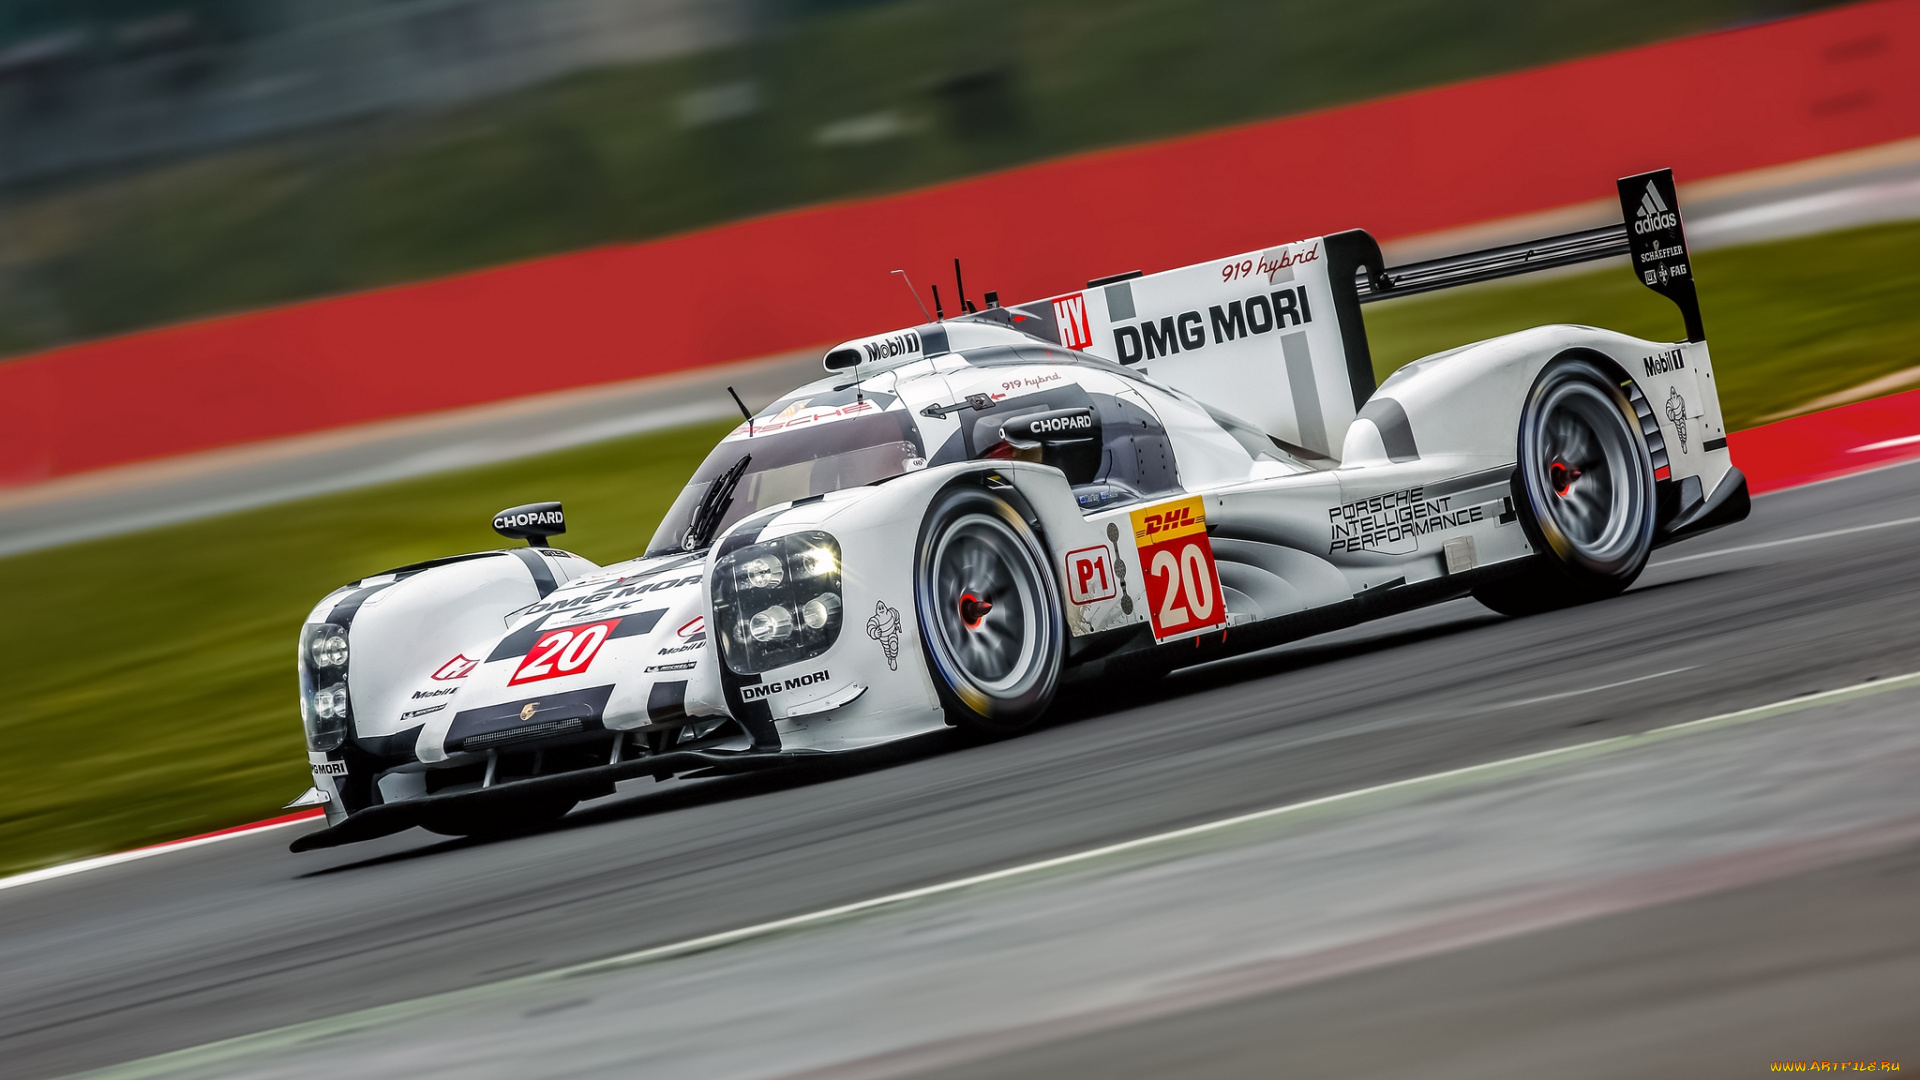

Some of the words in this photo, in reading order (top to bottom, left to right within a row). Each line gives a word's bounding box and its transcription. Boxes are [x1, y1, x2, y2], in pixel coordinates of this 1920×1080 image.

[1634, 212, 1677, 235] adidas
[1222, 260, 1252, 283] 919
[1256, 243, 1319, 284] hybrid
[1640, 245, 1684, 263] SCHAEFFLER
[1670, 264, 1687, 277] FAG
[1053, 296, 1087, 349] HY
[1112, 310, 1206, 366] DMG
[1208, 285, 1313, 345] MORI
[1001, 380, 1022, 391] 919
[1024, 372, 1062, 388] hybrid
[1030, 415, 1092, 433] CHOPARD
[494, 511, 564, 529] CHOPARD
[1144, 506, 1196, 536] DHL
[1328, 487, 1424, 523] PORSCHE
[1331, 497, 1451, 540] INTELLIGENT
[1328, 506, 1484, 555] PERFORMANCE
[1076, 555, 1109, 595] P1
[1151, 543, 1213, 629] 20
[523, 591, 613, 616] DMG
[613, 574, 703, 599] MOR
[514, 624, 608, 681] 20
[742, 682, 783, 700] DMG
[785, 669, 830, 690] MORI
[319, 763, 345, 775] MORI
